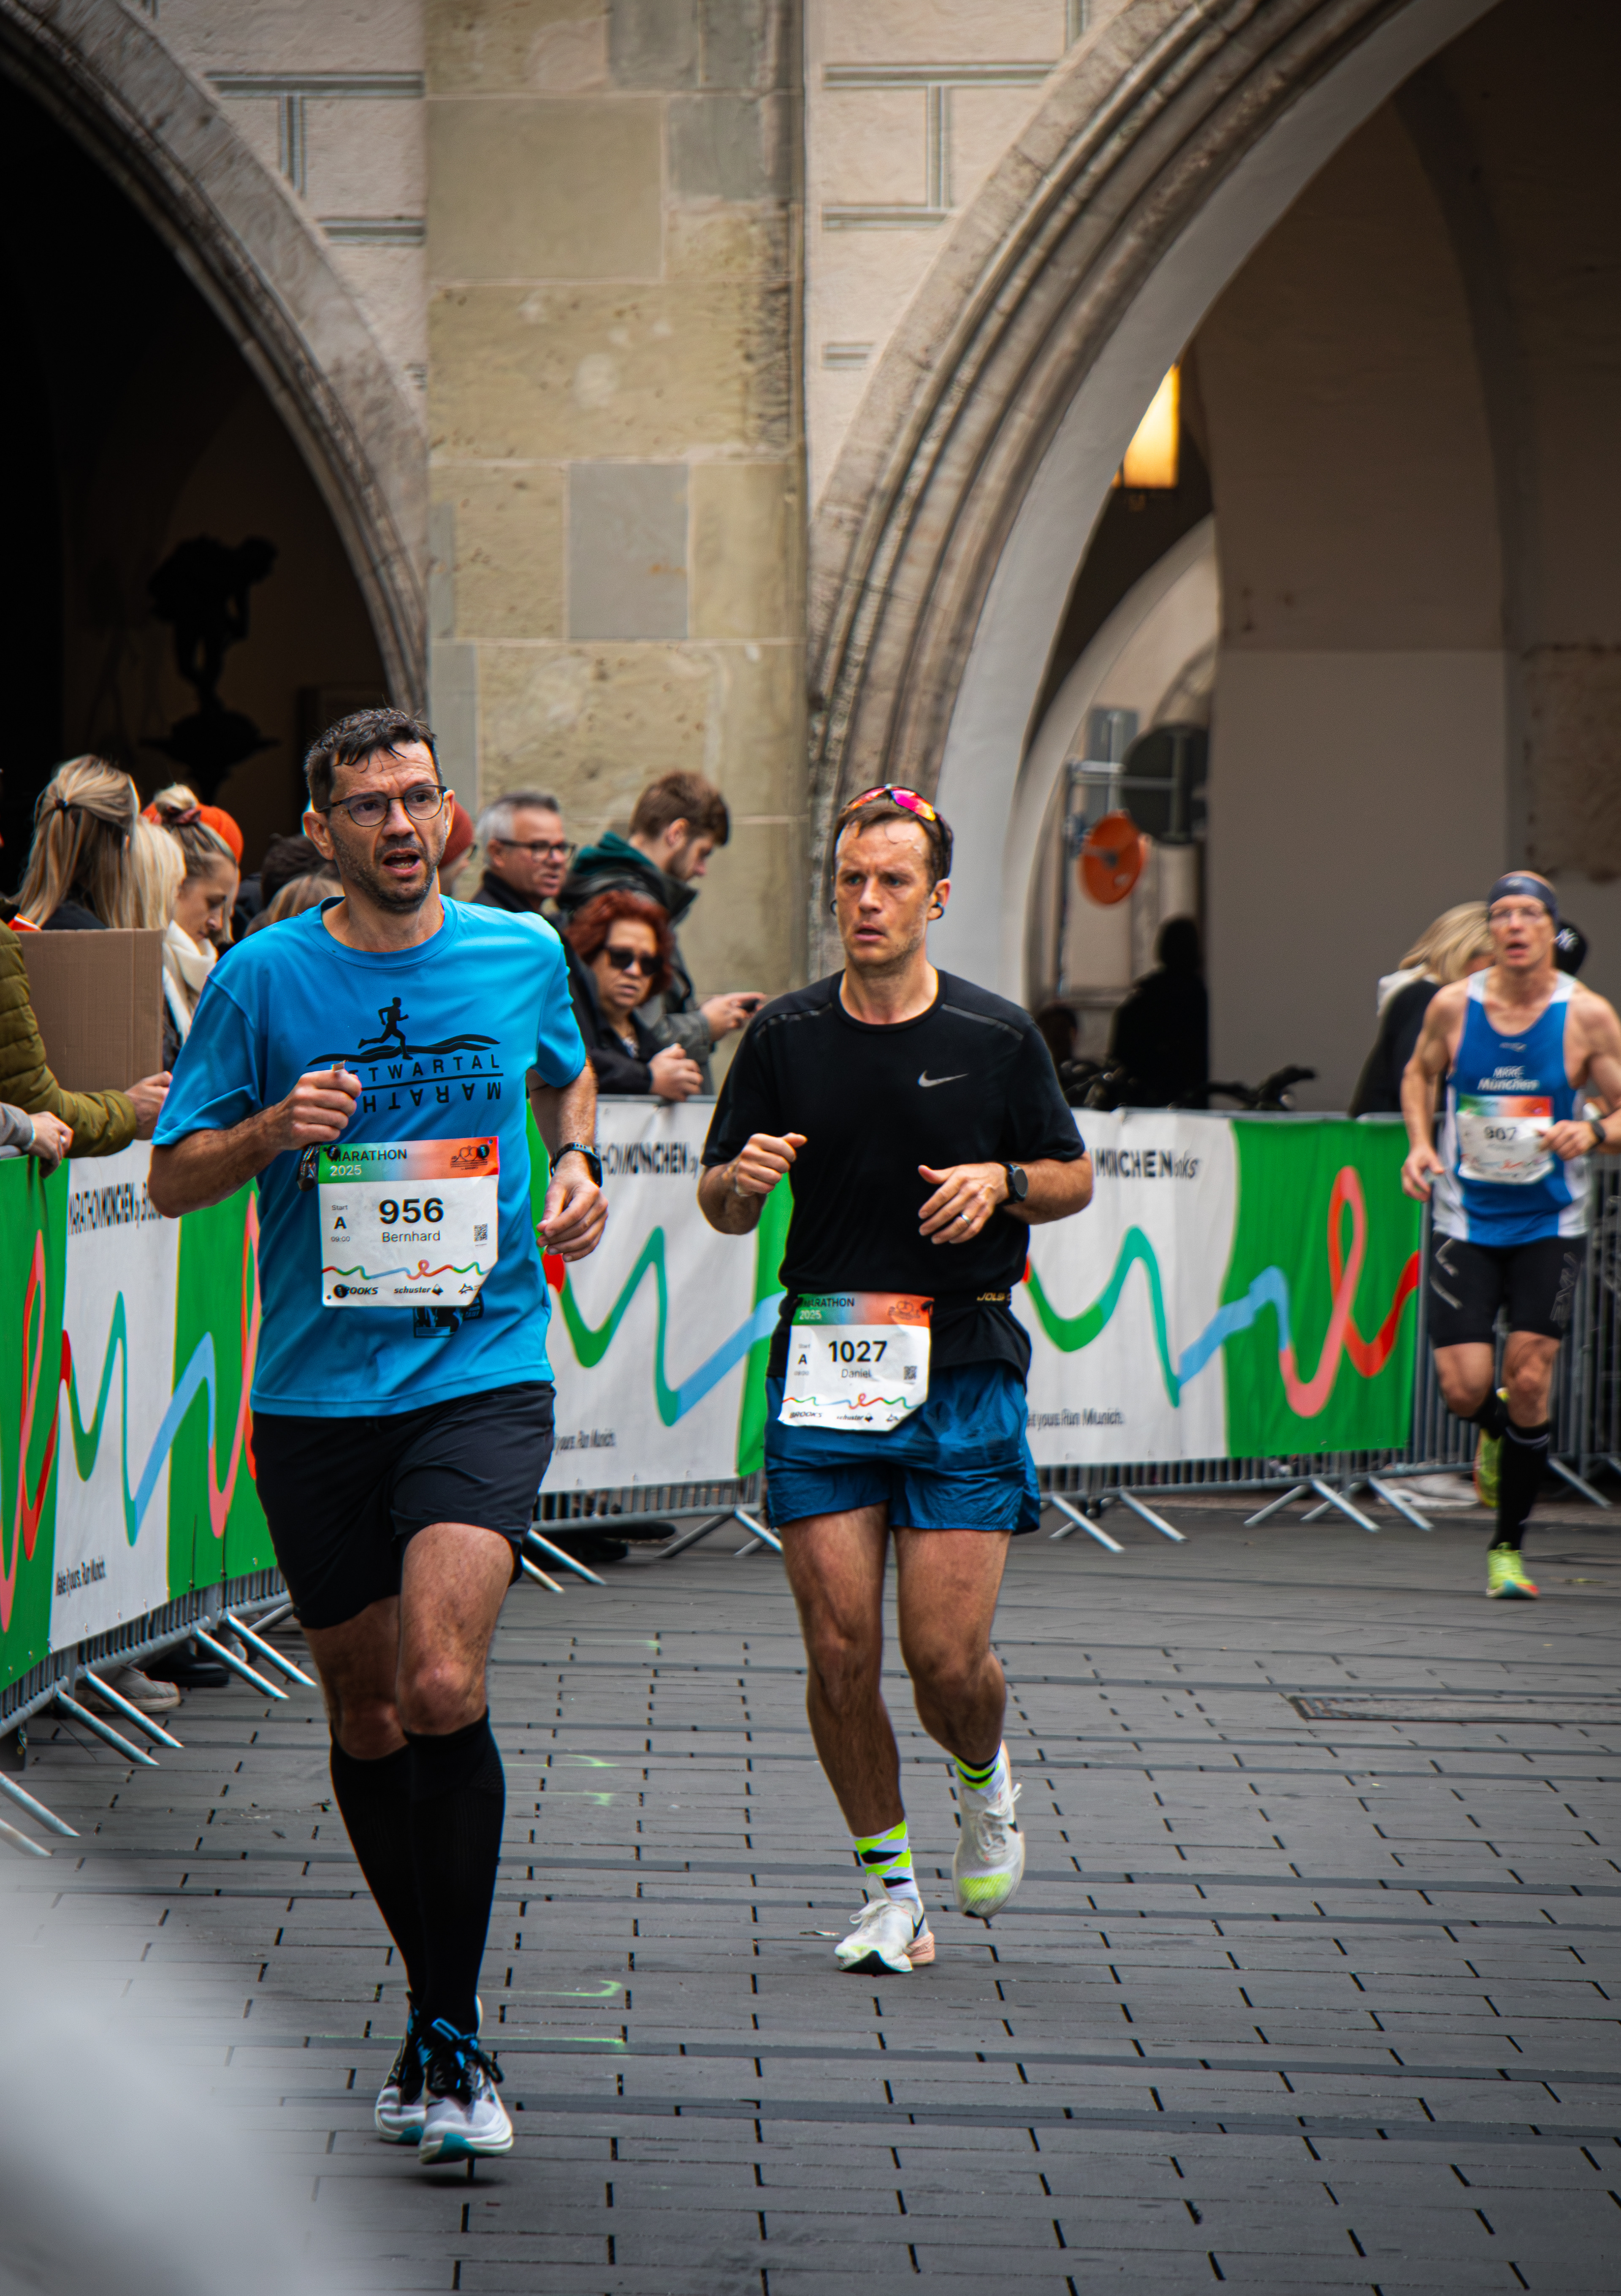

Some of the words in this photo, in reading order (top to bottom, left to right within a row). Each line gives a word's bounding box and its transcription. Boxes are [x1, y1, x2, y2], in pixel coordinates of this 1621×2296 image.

[349, 1054, 499, 1082] TWARTAL
[363, 1082, 501, 1113] MARATH
[330, 1164, 362, 1176] 2025
[379, 1197, 444, 1225] 956
[334, 1216, 347, 1229] A
[382, 1230, 440, 1242] Bernhard
[799, 1309, 822, 1320] 2025
[828, 1340, 887, 1363] 1027
[798, 1354, 807, 1364] A
[841, 1369, 871, 1378] Daniel
